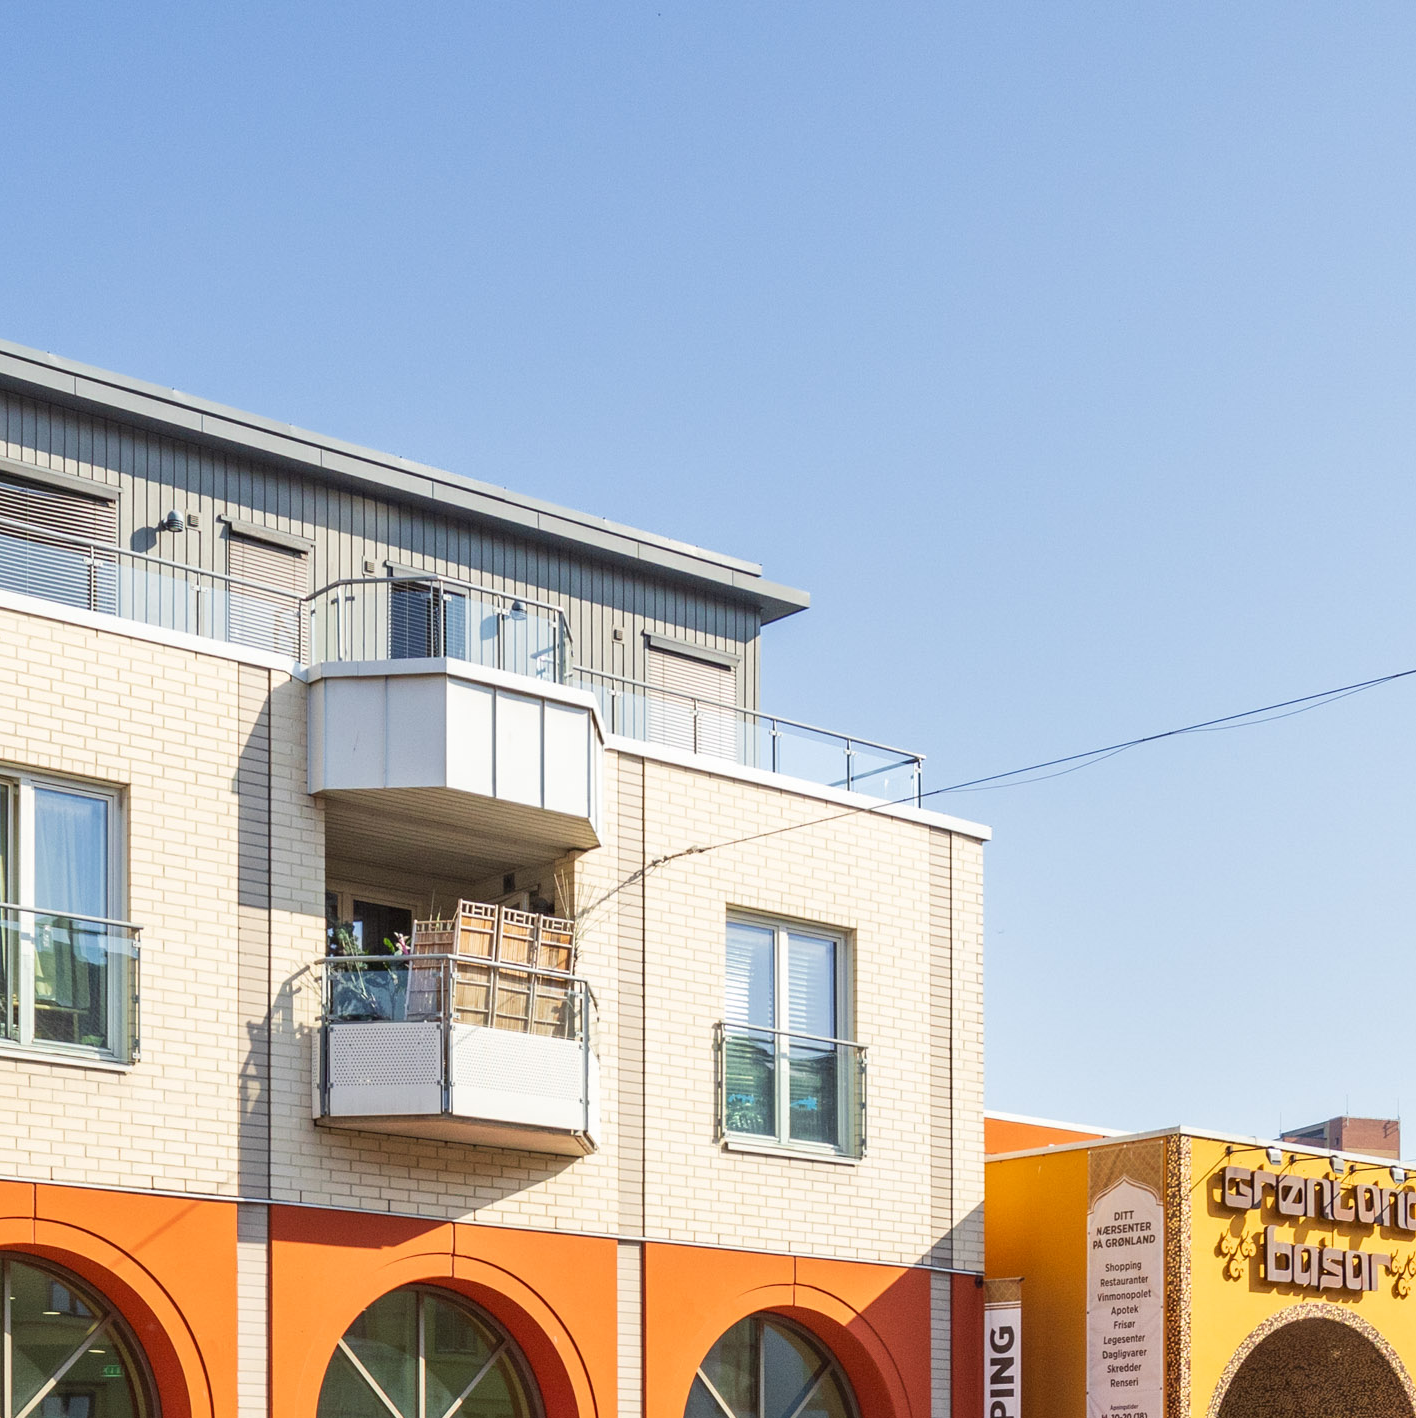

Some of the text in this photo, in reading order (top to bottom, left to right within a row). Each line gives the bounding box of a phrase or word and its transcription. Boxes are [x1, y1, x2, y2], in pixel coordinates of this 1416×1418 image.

[1113, 1210, 1135, 1221] DITT
[1096, 1221, 1152, 1236] NÆRSENTER
[1092, 1234, 1156, 1250] PÅ GRØNLAND
[1264, 1225, 1392, 1291] basar
[1105, 1260, 1142, 1272] Shopping
[1100, 1275, 1149, 1288] Restauranter
[1097, 1289, 1152, 1302] Vinmonopolet
[1110, 1304, 1139, 1316] Apotek
[1113, 1320, 1136, 1330] Frisør
[1103, 1334, 1146, 1346] Legesenter
[1102, 1348, 1147, 1360] Dagligvarer
[1106, 1363, 1142, 1374] Skredder
[1110, 1377, 1139, 1388] Renseri
